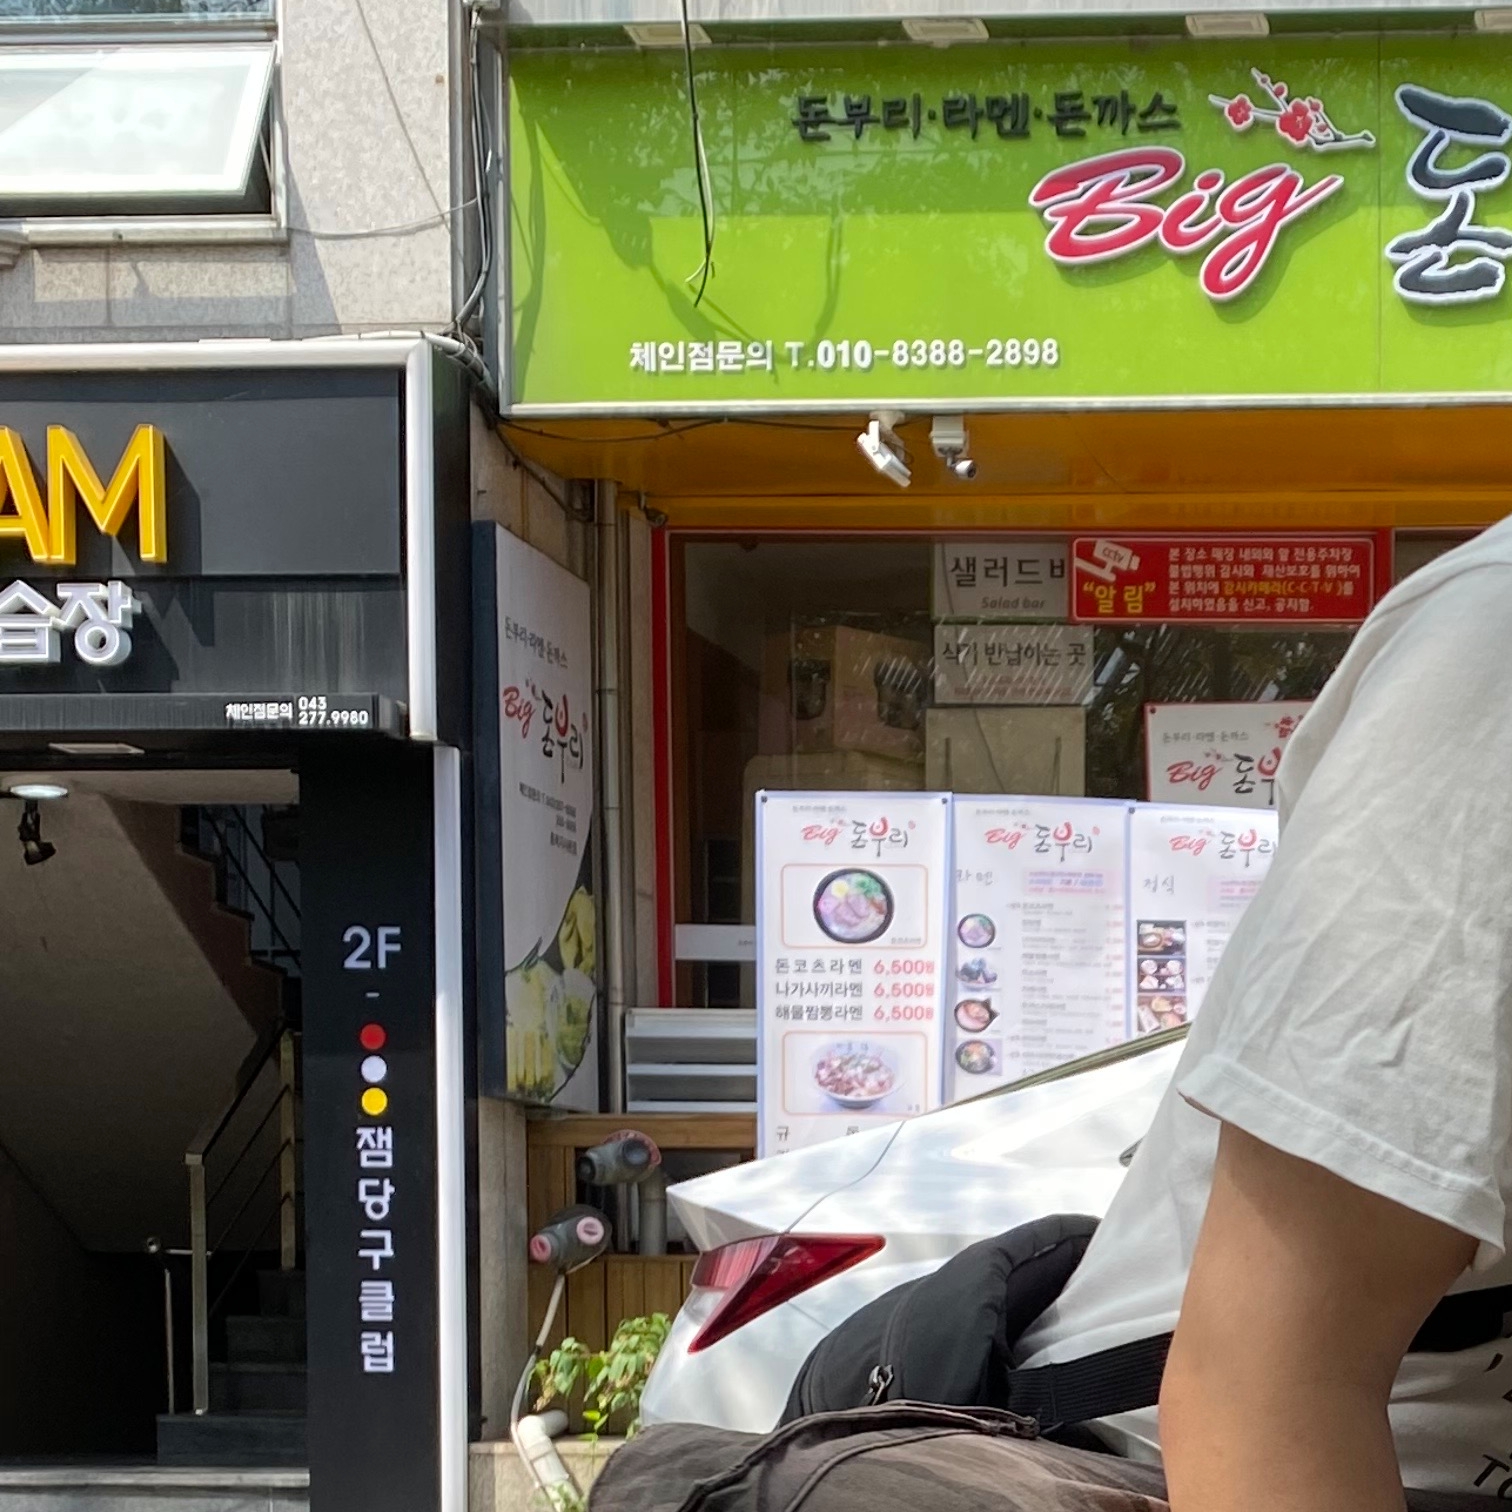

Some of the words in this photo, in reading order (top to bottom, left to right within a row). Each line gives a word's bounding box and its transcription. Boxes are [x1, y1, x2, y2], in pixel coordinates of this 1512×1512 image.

[1030, 146, 1344, 304] Big
[629, 340, 773, 373] 체인점문의
[982, 596, 1020, 609] Salad
[1023, 596, 1046, 609] bar
[226, 701, 294, 723] 체인점문의
[298, 696, 328, 711] 043
[298, 710, 370, 727] 277.9980
[503, 686, 535, 739] Big
[1166, 760, 1224, 791] Big
[1232, 746, 1282, 806] 돈부
[850, 816, 909, 858] 돈부리
[1033, 822, 1093, 862] 돈부리
[342, 925, 402, 970] 2F
